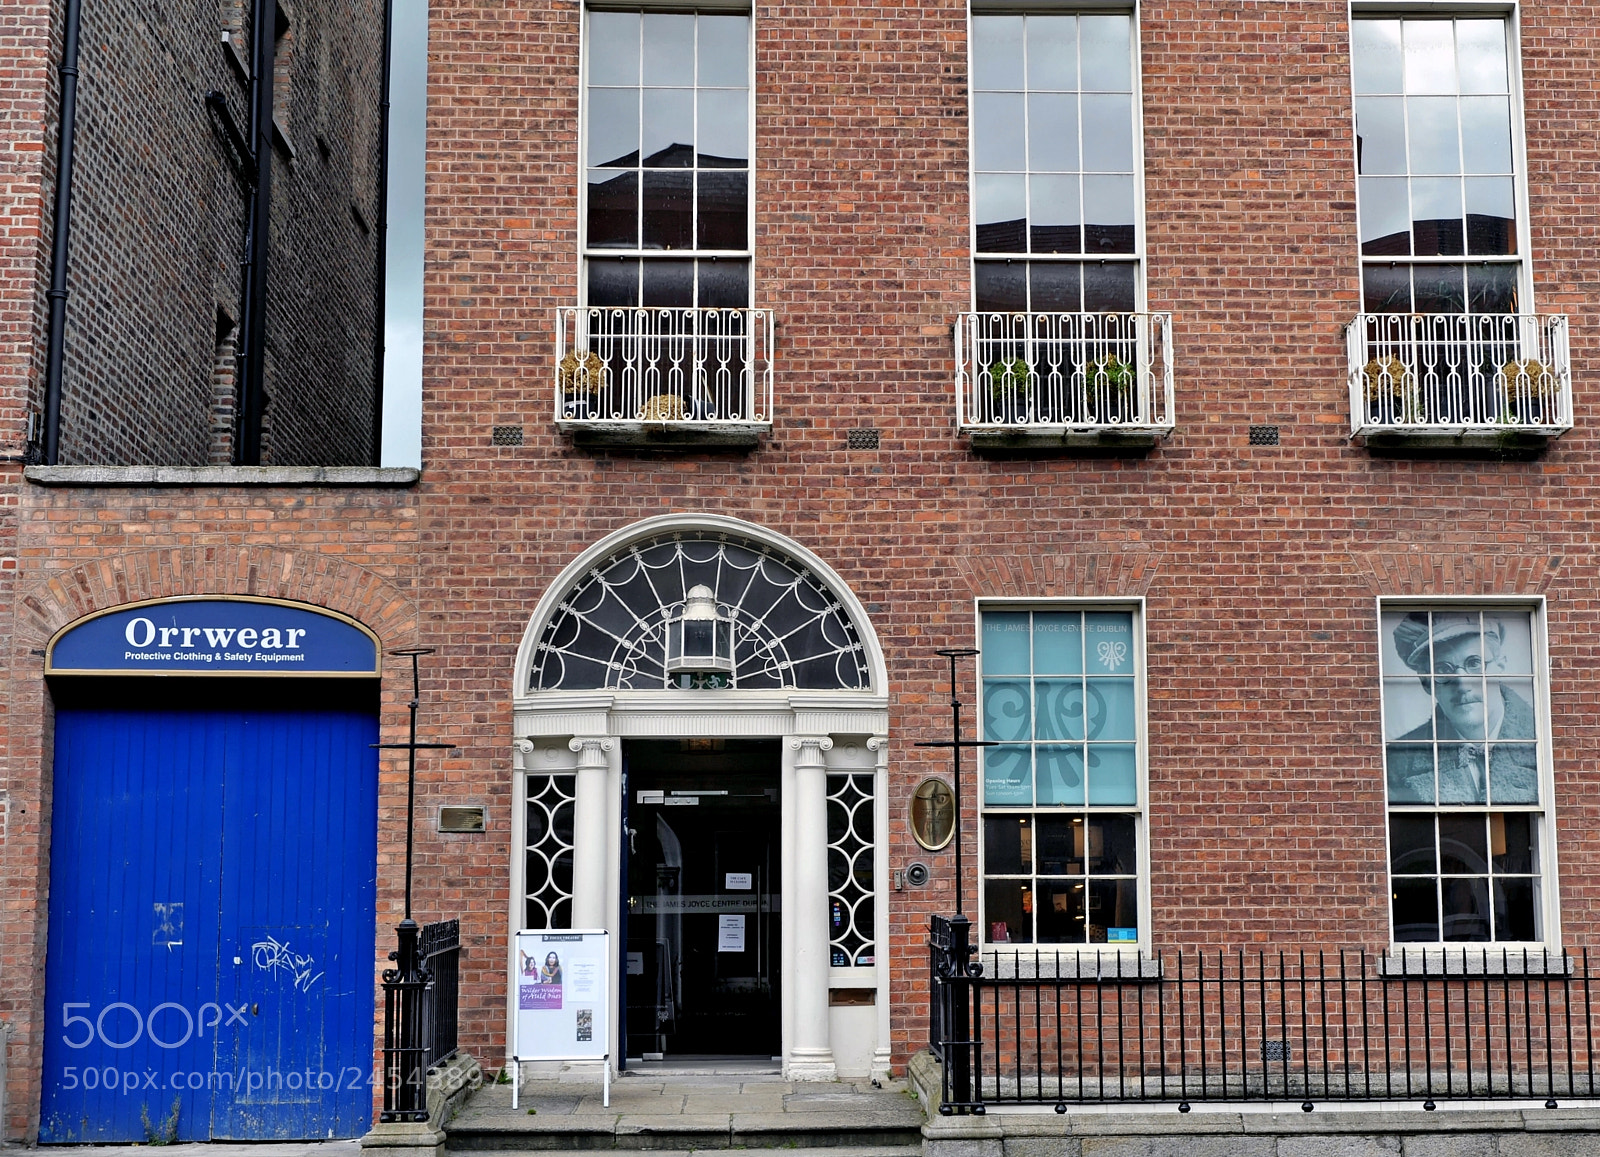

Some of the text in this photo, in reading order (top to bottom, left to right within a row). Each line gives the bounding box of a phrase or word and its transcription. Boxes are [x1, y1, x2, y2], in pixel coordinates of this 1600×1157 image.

[124, 617, 307, 648] Orrwear
[1034, 624, 1059, 632] JOYCE
[124, 652, 305, 663] Protective Clothing & Safety Equipment
[688, 900, 710, 908] JOYCE
